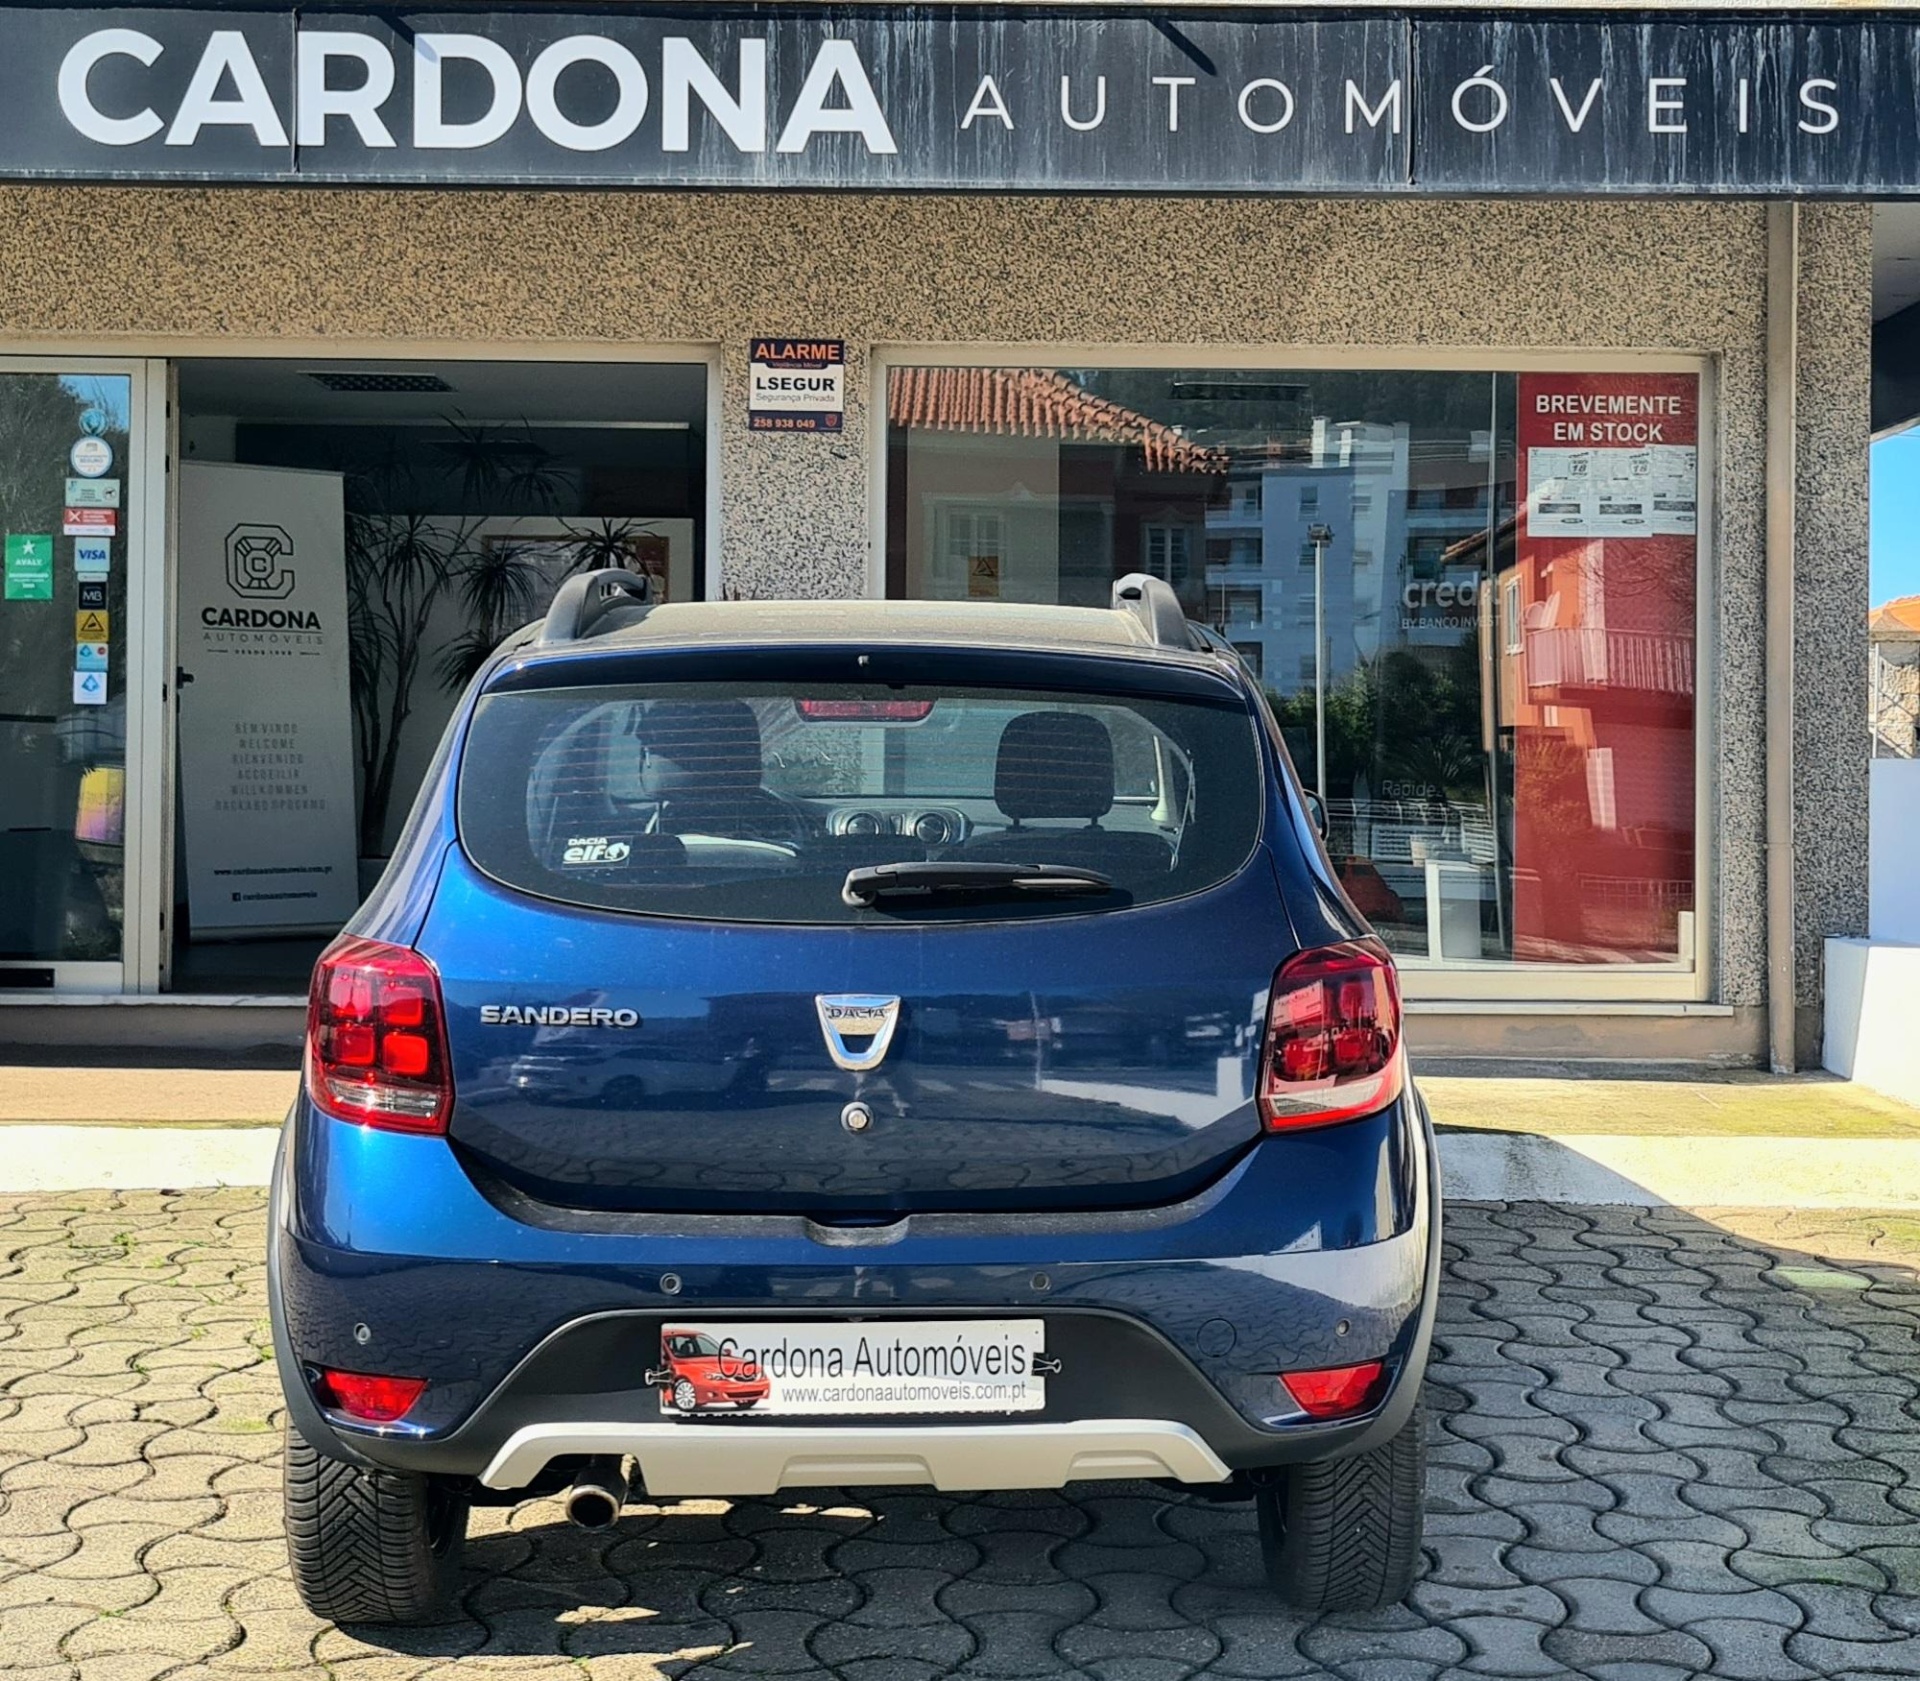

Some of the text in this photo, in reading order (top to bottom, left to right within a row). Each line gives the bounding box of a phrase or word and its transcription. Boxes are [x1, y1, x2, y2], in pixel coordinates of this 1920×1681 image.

[57, 27, 1840, 155] CARDONA AUTOMÓVEIS
[755, 343, 840, 360] ALARME
[756, 376, 835, 391] LSEGUR
[755, 393, 835, 403] Segurança Privada
[1535, 394, 1681, 415] BREVEMENTE
[753, 418, 816, 428] 258 938 049
[1553, 422, 1663, 442] EM STOCK
[79, 549, 107, 561] VISA
[82, 590, 103, 602] MB
[201, 606, 322, 630] CARDONA
[1401, 618, 1417, 630] BY
[1419, 616, 1459, 630] BANCO
[568, 837, 607, 846] DACIA
[563, 845, 607, 861] elf
[479, 1004, 640, 1028] SANDERO
[828, 1007, 886, 1019] DACIA
[717, 1334, 1027, 1379] Cardona Automóveis
[781, 1380, 1027, 1404] www.cardonaautomoveis.com.pt
